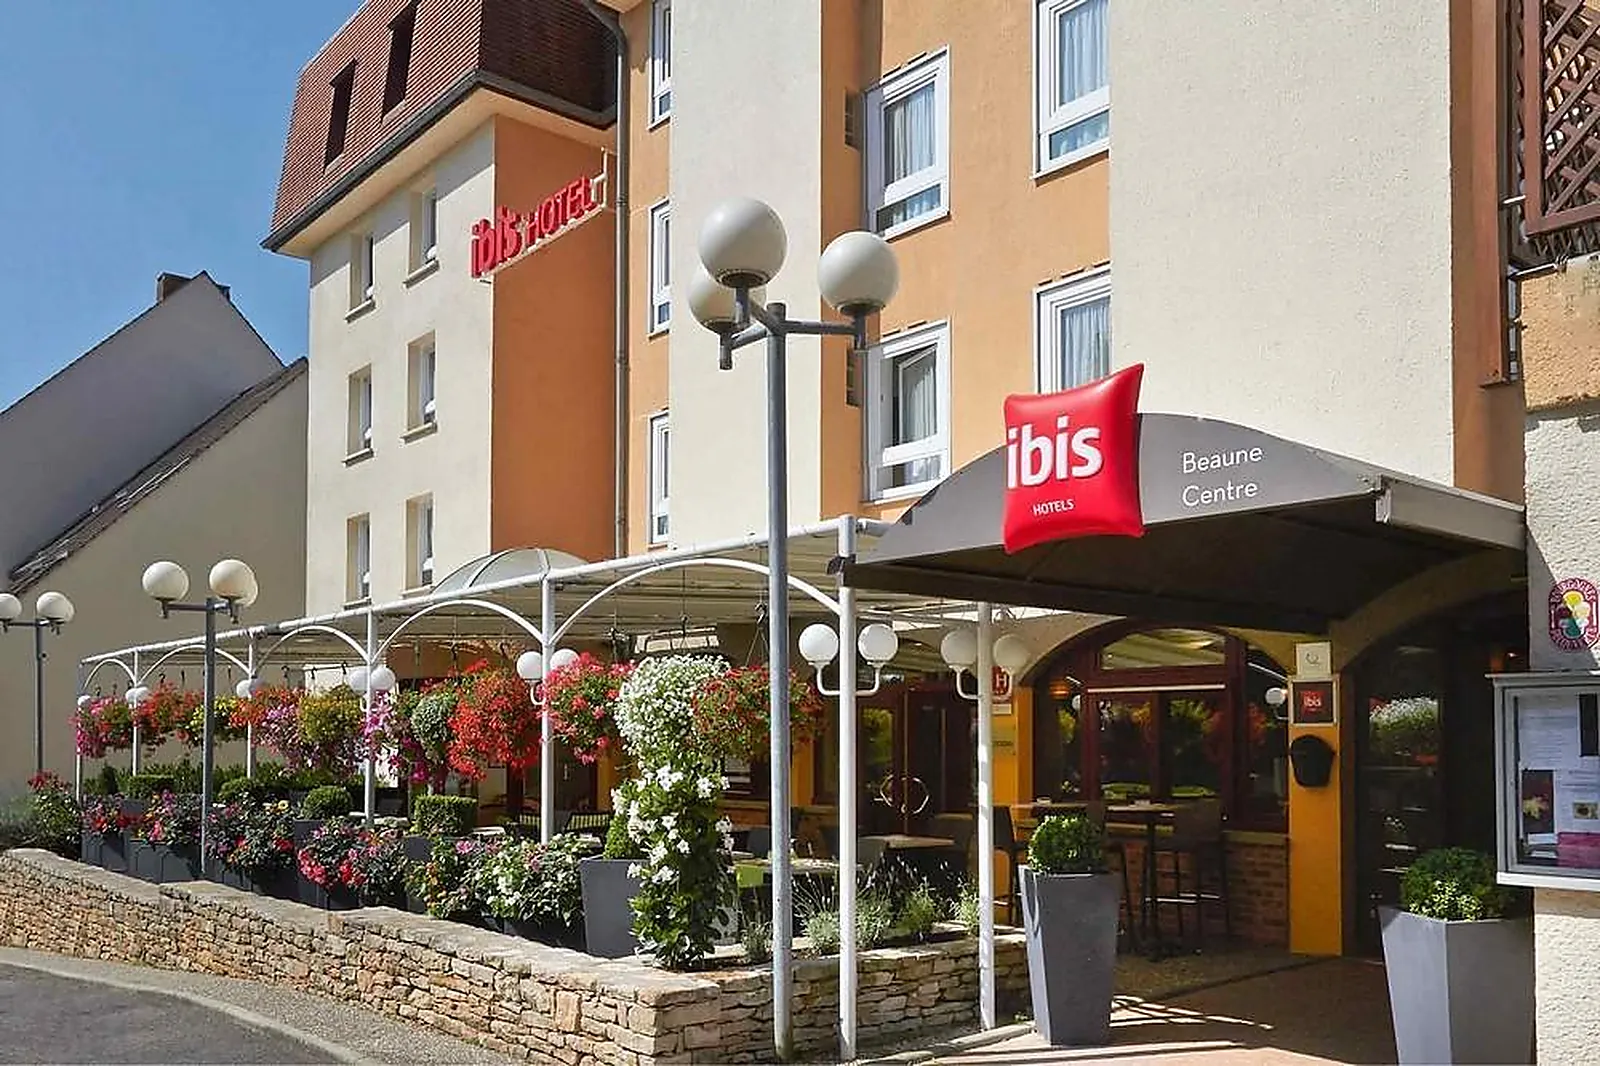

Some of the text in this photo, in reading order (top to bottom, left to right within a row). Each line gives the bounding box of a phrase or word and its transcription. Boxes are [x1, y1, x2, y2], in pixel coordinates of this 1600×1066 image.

[470, 175, 596, 278] ibis HOTEL
[1006, 415, 1104, 490] ibis
[1182, 447, 1263, 474] Beaune
[1032, 498, 1075, 516] HOTELS
[1182, 480, 1258, 507] Centre
